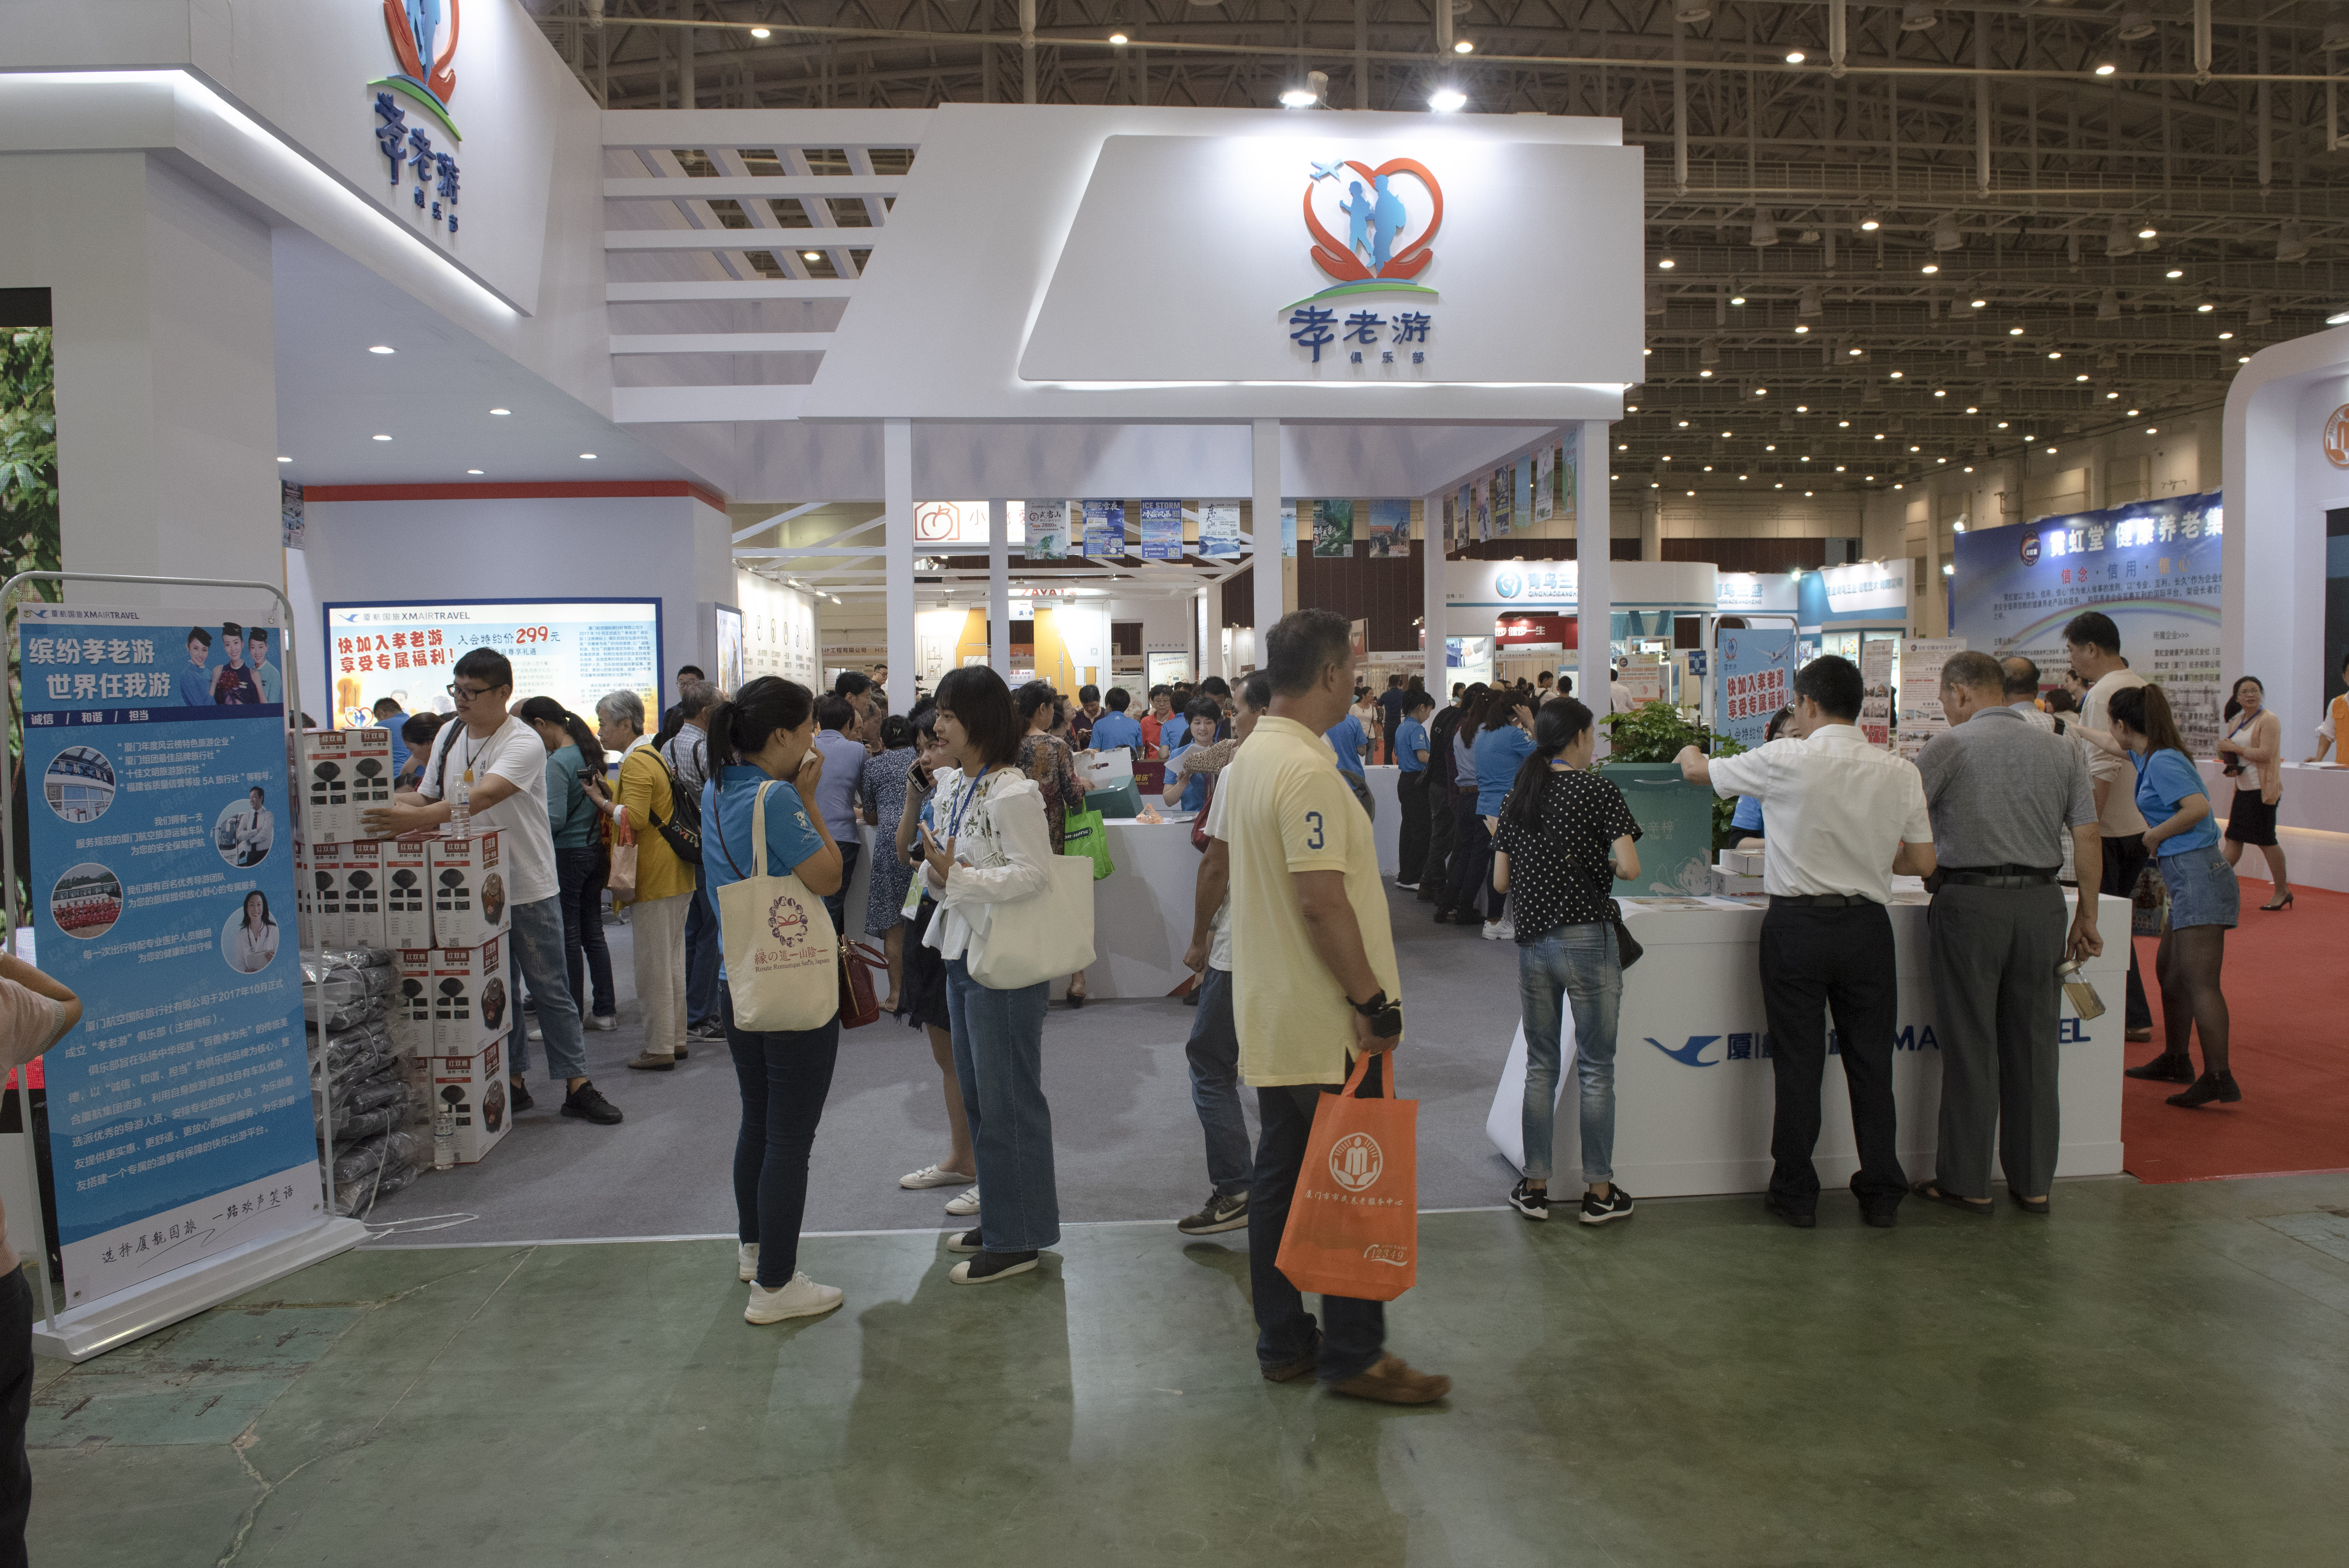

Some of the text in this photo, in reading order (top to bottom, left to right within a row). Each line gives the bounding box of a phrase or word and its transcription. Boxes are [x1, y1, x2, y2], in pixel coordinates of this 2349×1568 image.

[375, 92, 460, 205] 孝老游
[1290, 305, 1431, 363] 孝老游
[1350, 351, 1424, 363] 俱乐部
[1039, 510, 1061, 519] 武当山
[1527, 573, 1578, 589] 青鸟三
[2062, 555, 2190, 584] 信念 信用 信心
[84, 611, 139, 620] XMAIRTRAVEL
[402, 612, 471, 620] XMAIRTRAVEL
[29, 637, 155, 665] 缤纷孝老游
[338, 629, 443, 655] 快加入孝老游
[340, 648, 454, 674] 享受专属福利！
[46, 672, 171, 700] 世界任我游
[1727, 668, 1784, 697] 快加入孝老游
[31, 714, 54, 725] 诚信
[82, 711, 103, 723] 和谐
[129, 710, 149, 722] 担当
[154, 813, 203, 827] 我们拥有一支
[1306, 811, 1324, 850] 3
[76, 825, 204, 849] 服务规范的厦门航空旅游运输车队
[131, 838, 205, 856] 为您的安全保驾护航
[127, 873, 225, 896] 我们拥有百名优秀导游团队
[128, 880, 257, 909] 为您的旅程提供放心舒心的专属服务
[138, 941, 212, 964] 为您的健康时刻守候
[773, 962, 800, 970] Romantique
[815, 958, 830, 966] Japan
[85, 978, 284, 1033] 厦门航空国际旅行社有限公司于2017年10月正式
[1305, 1189, 1403, 1206] 厦门市市民养老服务中心
[102, 1185, 293, 1263] 选择厦航国旅 一路欢声笑语
[1371, 1248, 1404, 1260] 12349
